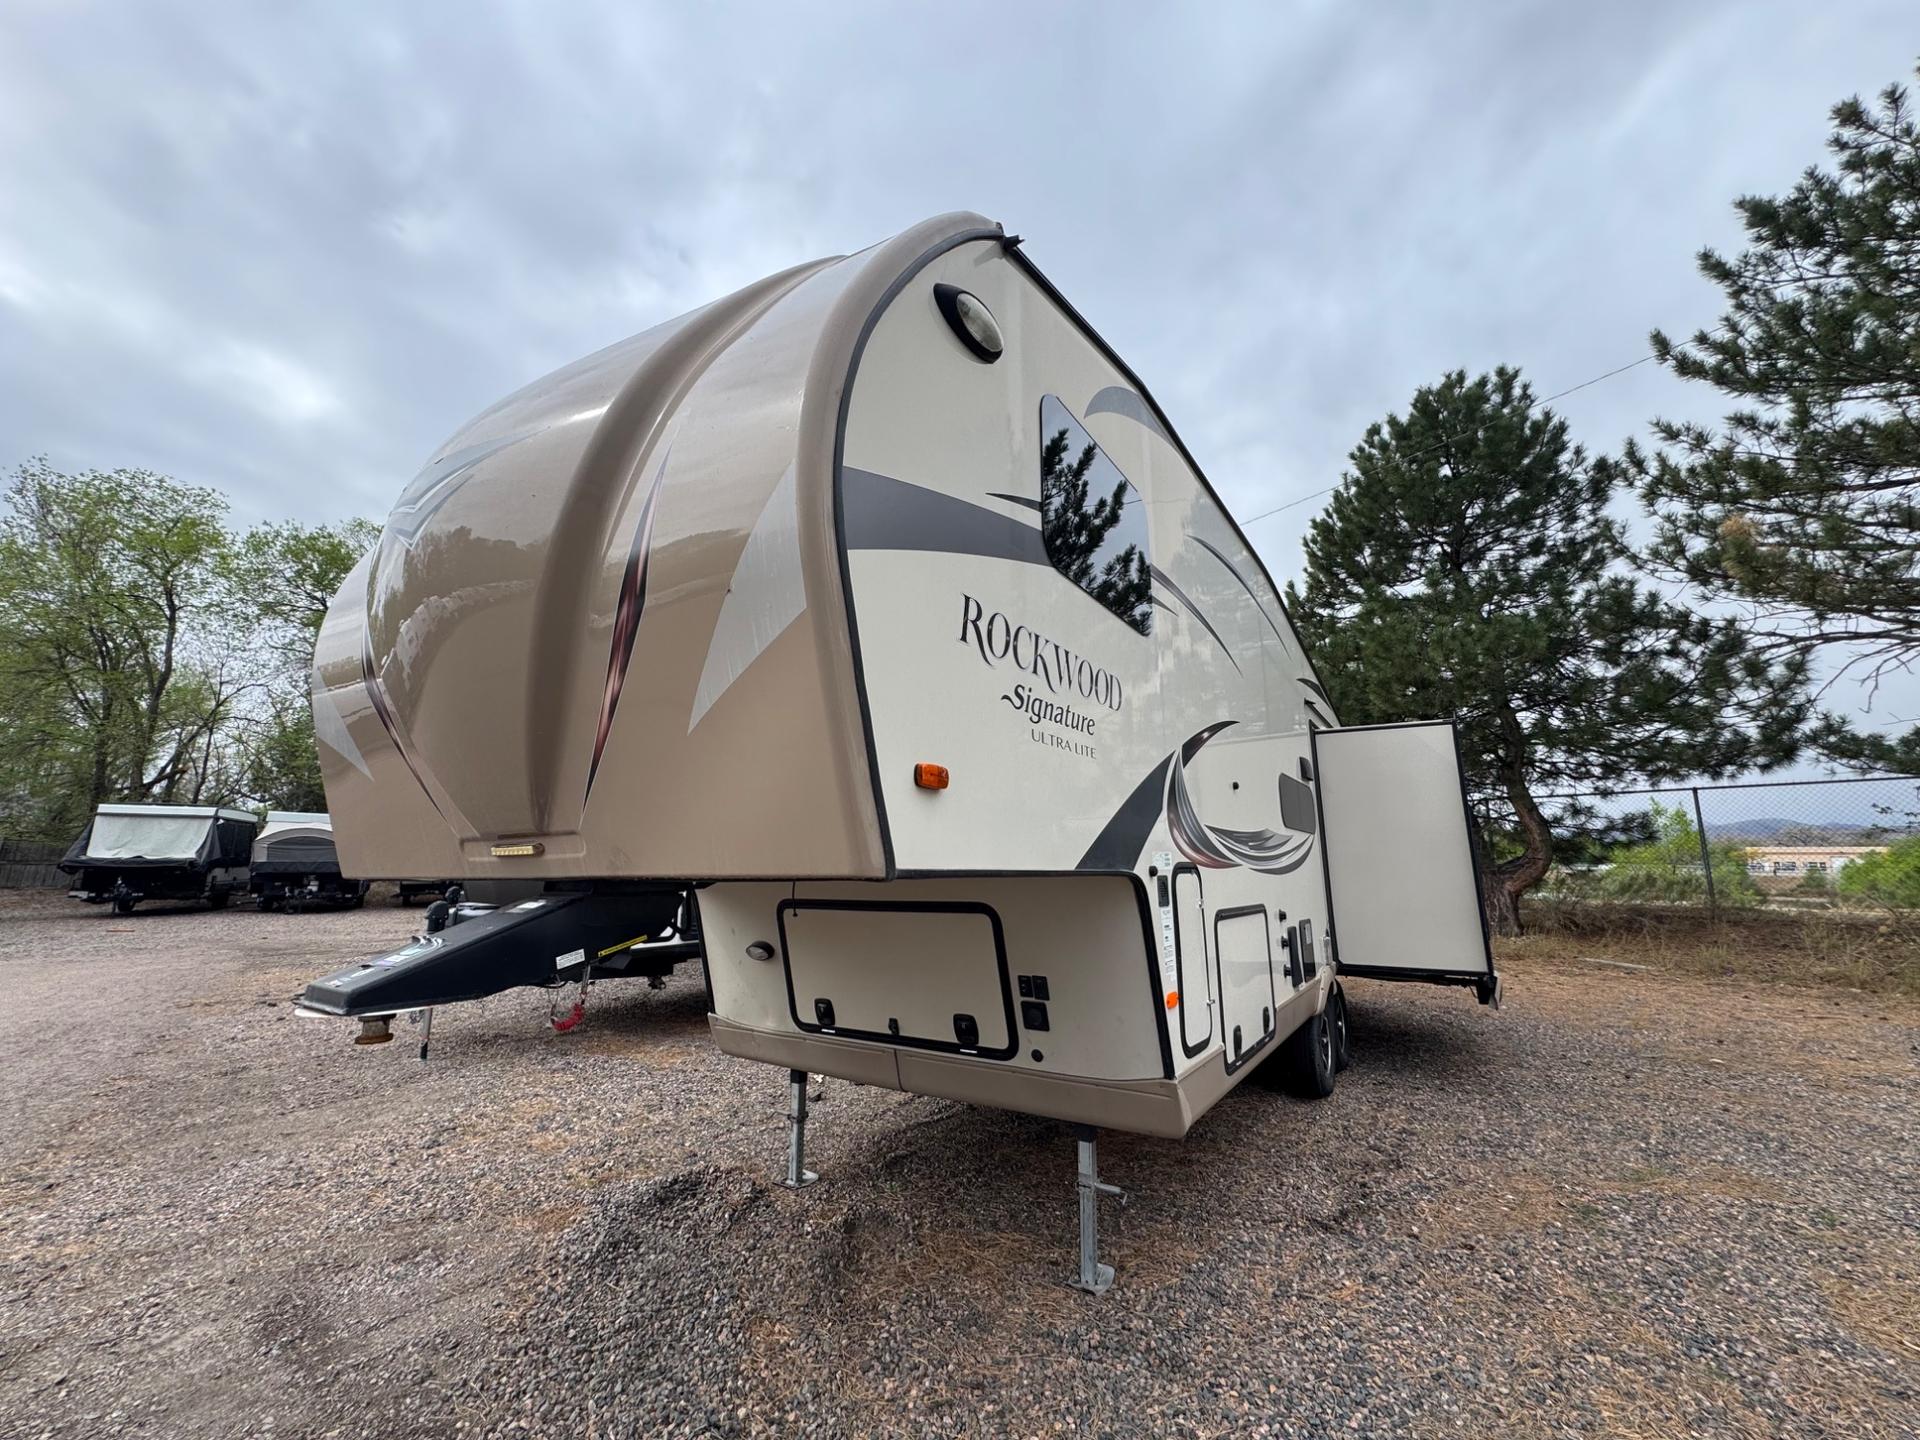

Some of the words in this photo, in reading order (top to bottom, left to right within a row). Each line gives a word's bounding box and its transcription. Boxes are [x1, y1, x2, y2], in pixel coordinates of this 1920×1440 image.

[960, 592, 1122, 711] ROCKWOOD
[1001, 684, 1096, 736] Signature
[1031, 728, 1072, 752] ULTRA
[1074, 742, 1097, 760] LITE
